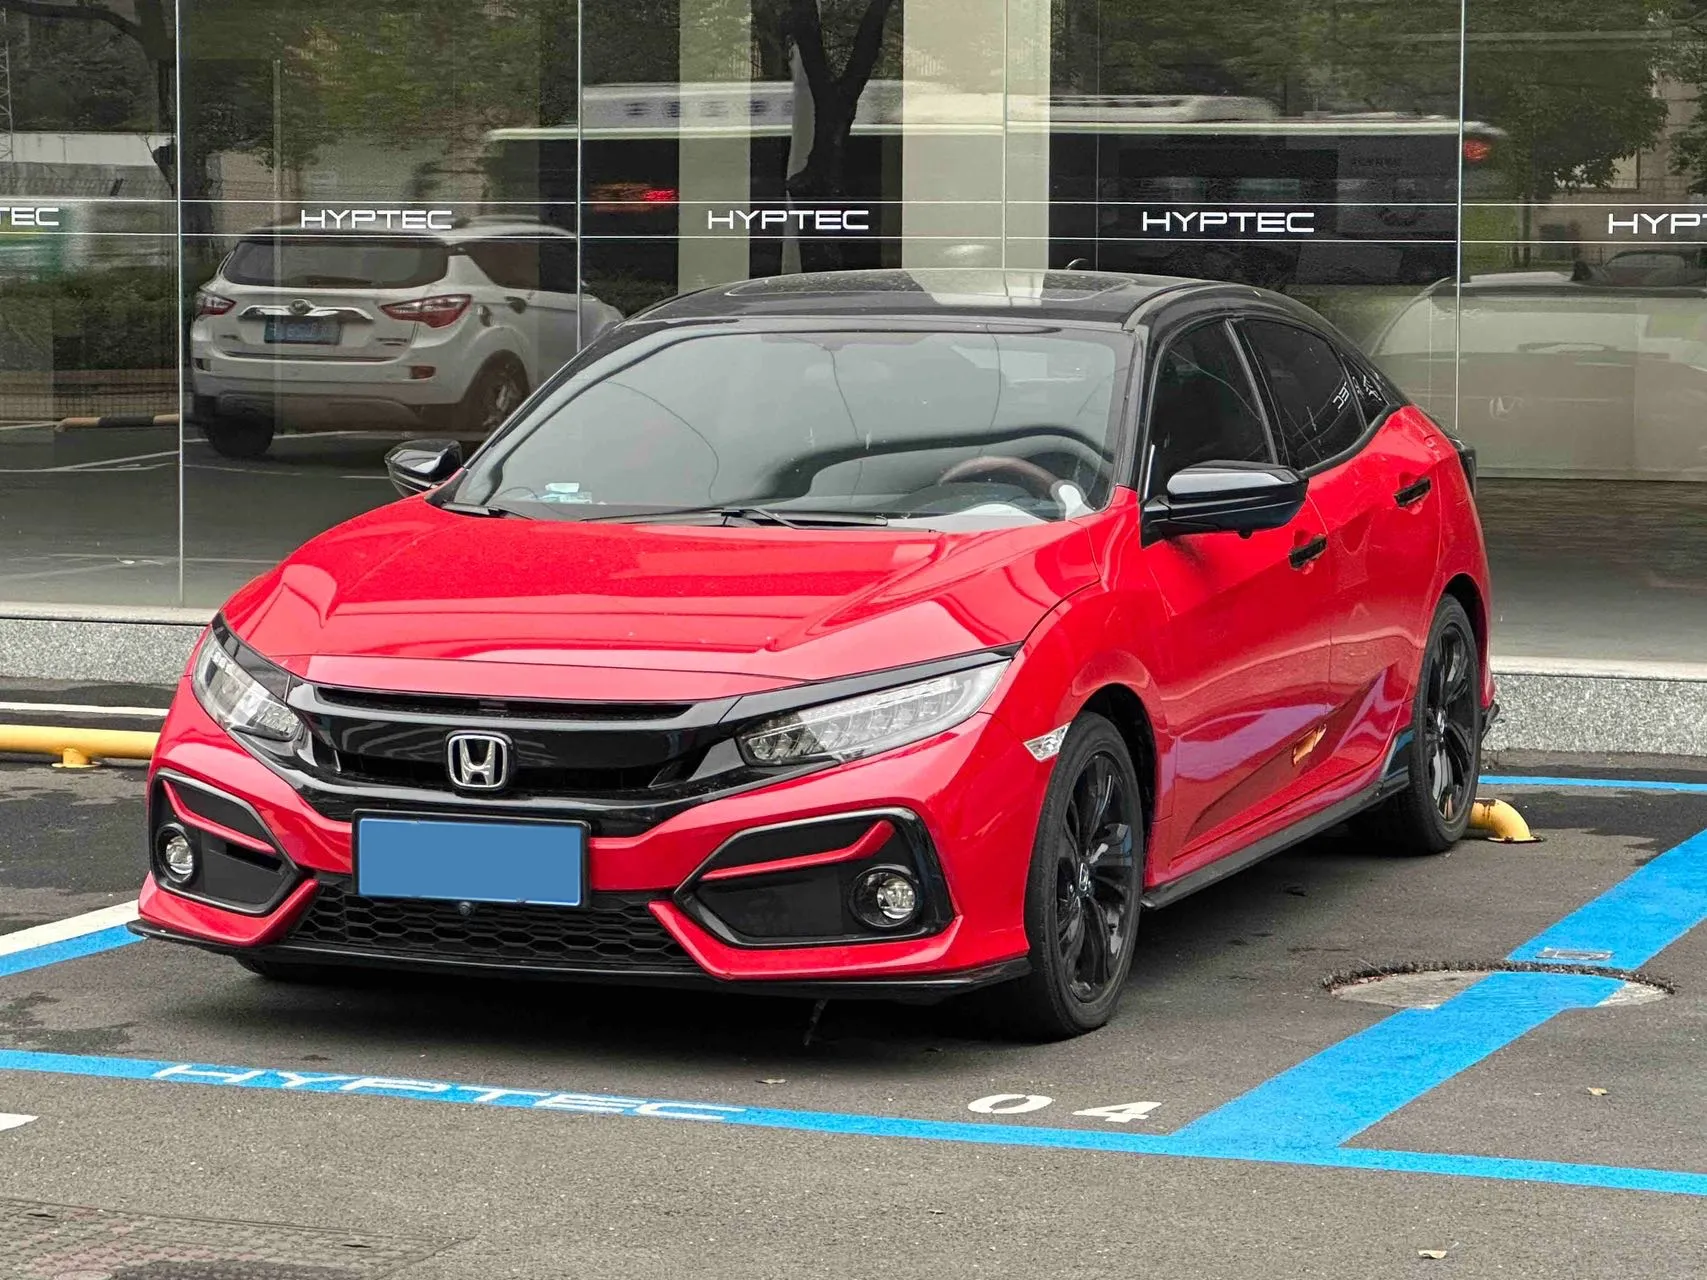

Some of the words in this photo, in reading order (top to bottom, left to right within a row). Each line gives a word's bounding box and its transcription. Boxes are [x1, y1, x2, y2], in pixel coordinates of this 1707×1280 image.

[301, 209, 452, 229] HYPTEC
[707, 210, 870, 230] HYPTEC
[1142, 211, 1315, 233] HYPTEC
[1608, 213, 1707, 234] HYP
[153, 1063, 747, 1121] HYPTEC
